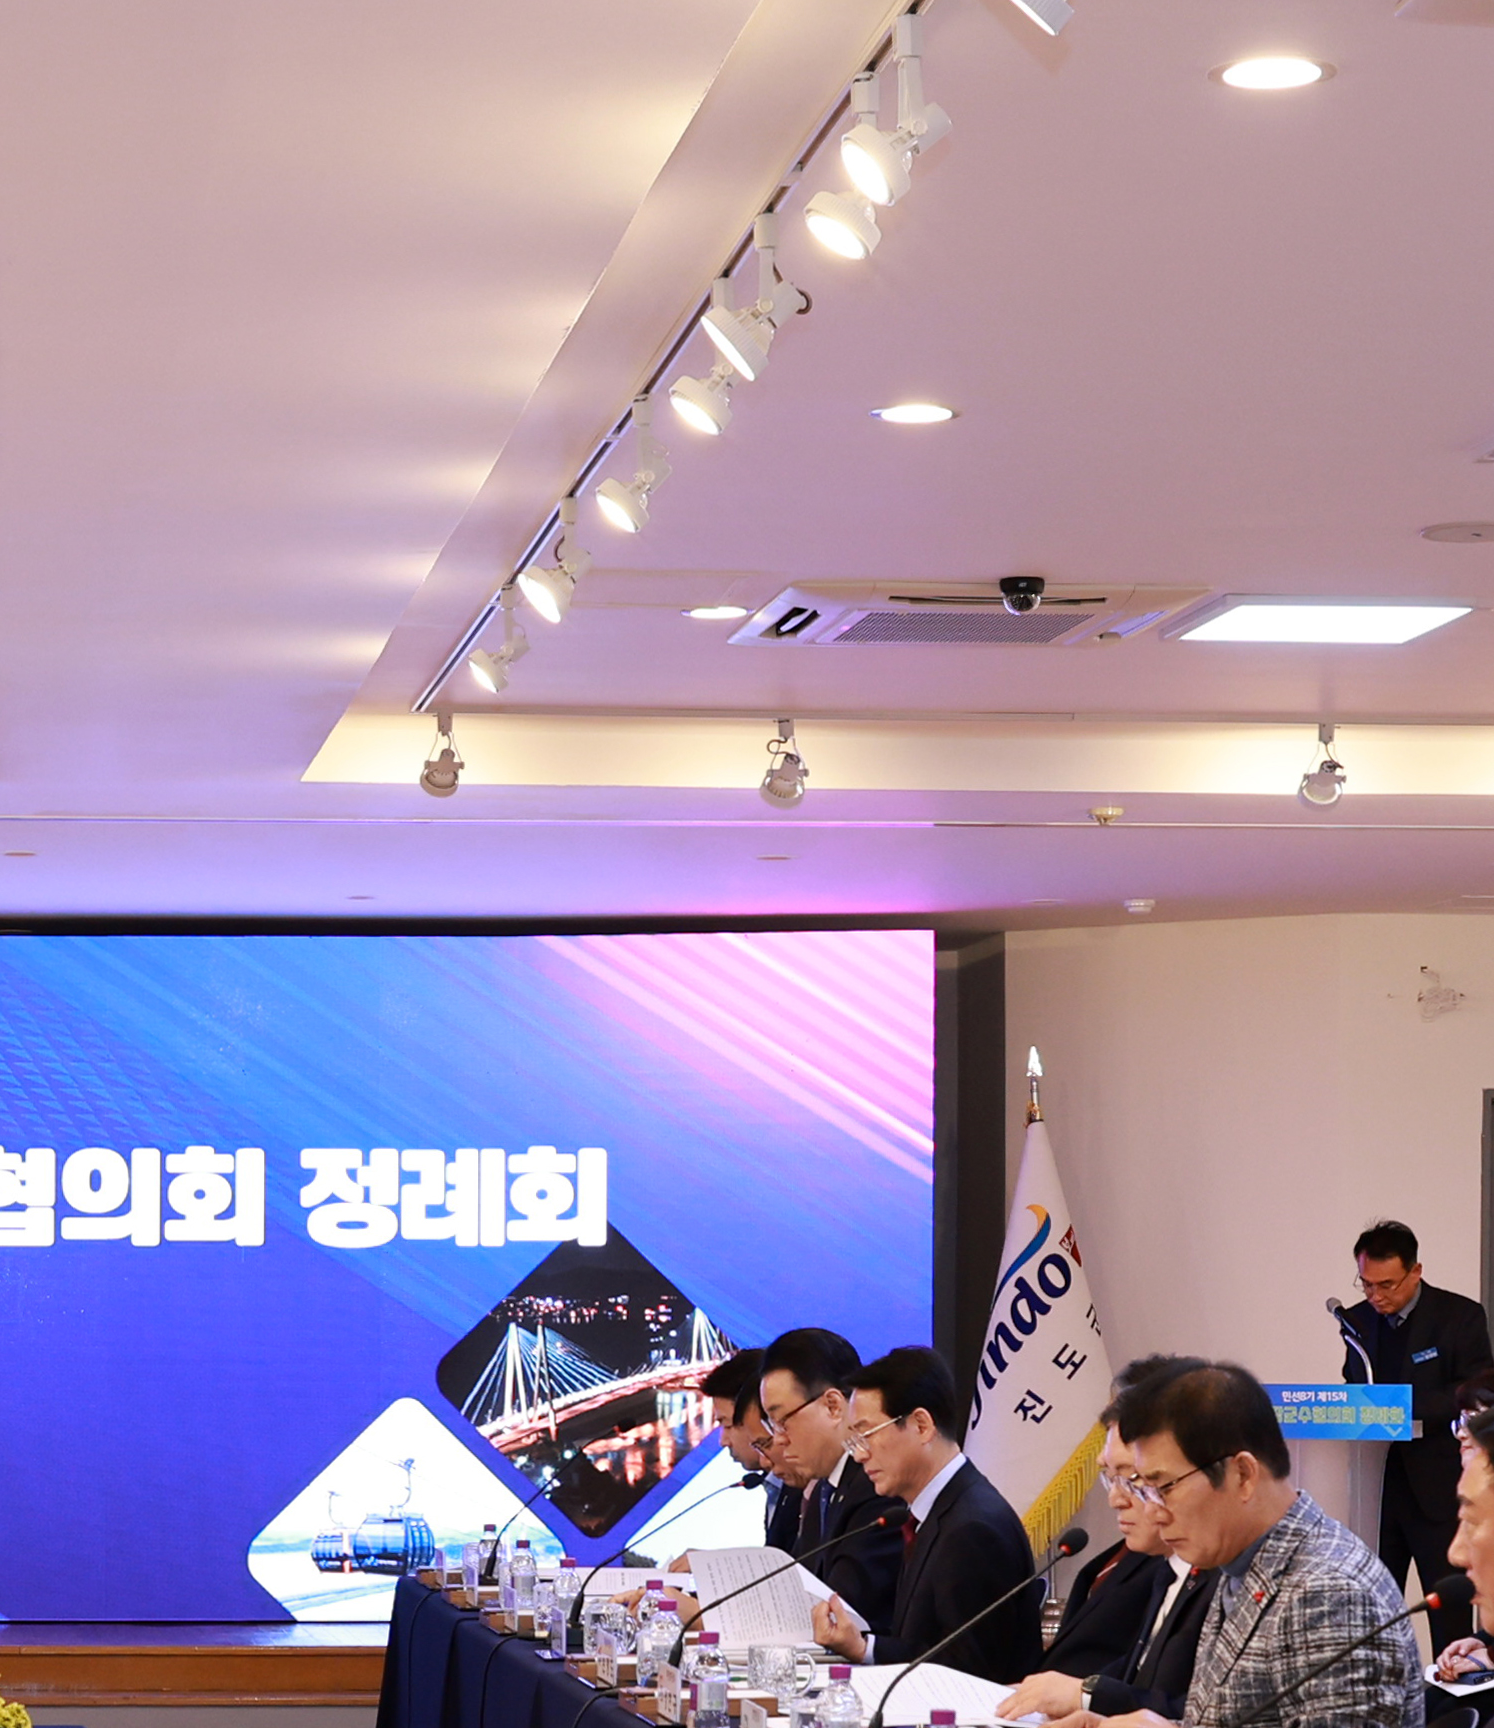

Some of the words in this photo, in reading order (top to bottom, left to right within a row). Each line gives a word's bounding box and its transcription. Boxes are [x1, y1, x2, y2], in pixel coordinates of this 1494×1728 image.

[301, 1146, 607, 1248] 정례회
[1282, 1390, 1315, 1402] 민선8기
[1317, 1390, 1348, 1402] 제15차
